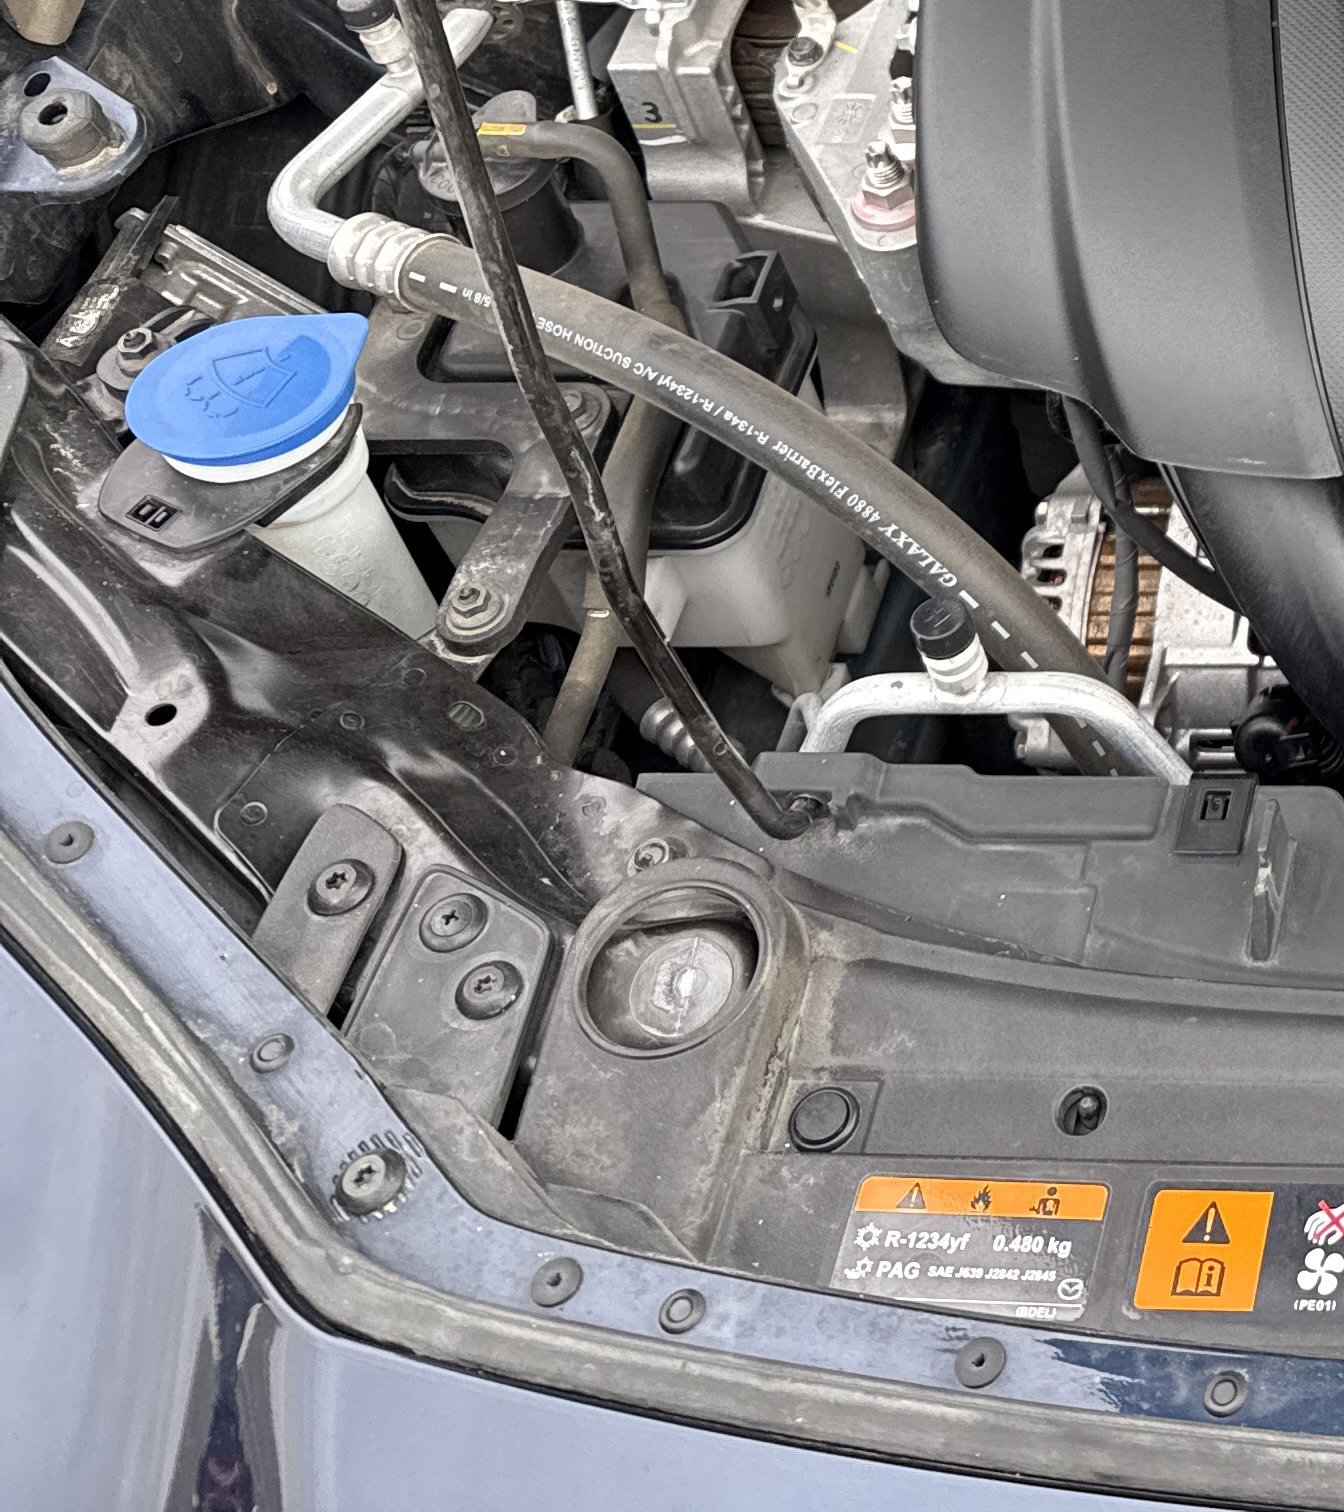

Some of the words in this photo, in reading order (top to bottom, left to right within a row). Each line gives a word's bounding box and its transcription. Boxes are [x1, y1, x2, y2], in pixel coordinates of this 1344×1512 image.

[641, 101, 663, 124] 3
[536, 316, 573, 342] HOSE
[573, 332, 633, 370] SUCTION
[632, 361, 659, 382] A/C
[656, 373, 715, 414] R-1234yf
[713, 405, 725, 417] /
[723, 409, 770, 446] R-134a
[771, 440, 850, 501] FlexBarrier
[847, 493, 881, 524] 4880
[877, 522, 958, 588] GALAXY
[884, 1230, 972, 1255] R-1234yf
[992, 1234, 1045, 1253] 0.480
[1047, 1236, 1073, 1259] kg
[875, 1260, 921, 1280] PAG
[927, 1265, 955, 1278] SAE
[955, 1266, 984, 1279] J639
[1293, 1299, 1337, 1313] (PE01)
